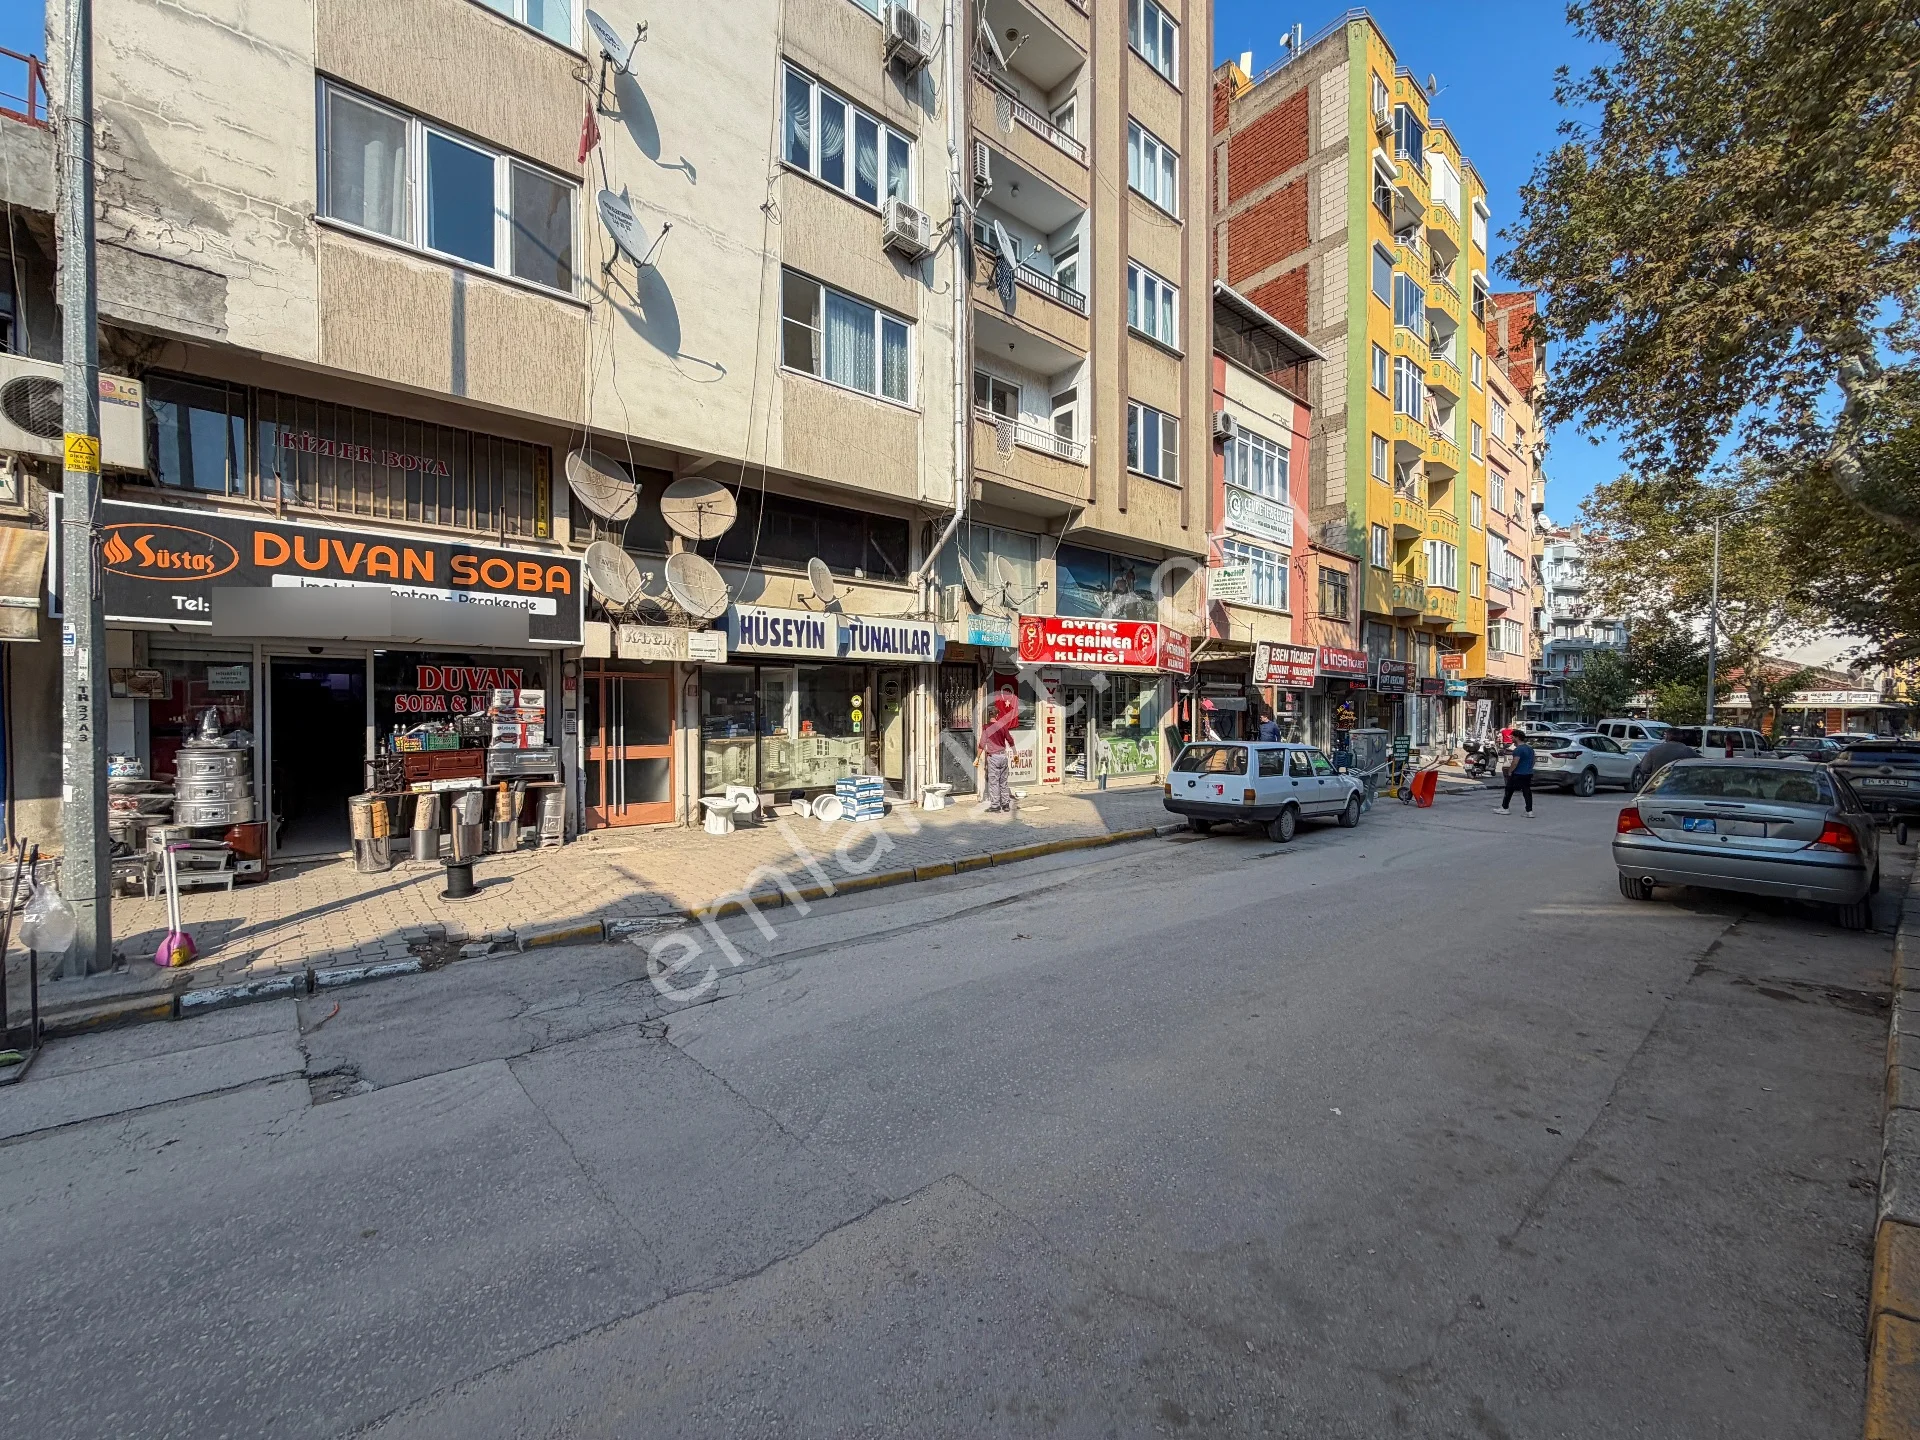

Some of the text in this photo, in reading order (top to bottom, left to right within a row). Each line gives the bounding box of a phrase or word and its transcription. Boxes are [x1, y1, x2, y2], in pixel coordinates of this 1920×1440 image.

[119, 386, 138, 396] LG
[382, 450, 450, 476] BOYA
[134, 534, 215, 573] Süstaş
[254, 531, 571, 595] DUVAN SOBA
[171, 595, 210, 612] Tel:
[740, 611, 825, 650] HÜSEYİN
[849, 623, 931, 656] TUNALILAR
[1061, 620, 1118, 634] AYTAÇ
[1046, 631, 1132, 650] VETERİNER
[1055, 650, 1125, 663] KLİNİĞİ
[1271, 647, 1315, 665] ESEN TİCARET
[416, 665, 523, 692] DUVAN
[394, 694, 448, 713] SOBA
[450, 694, 467, 713] &
